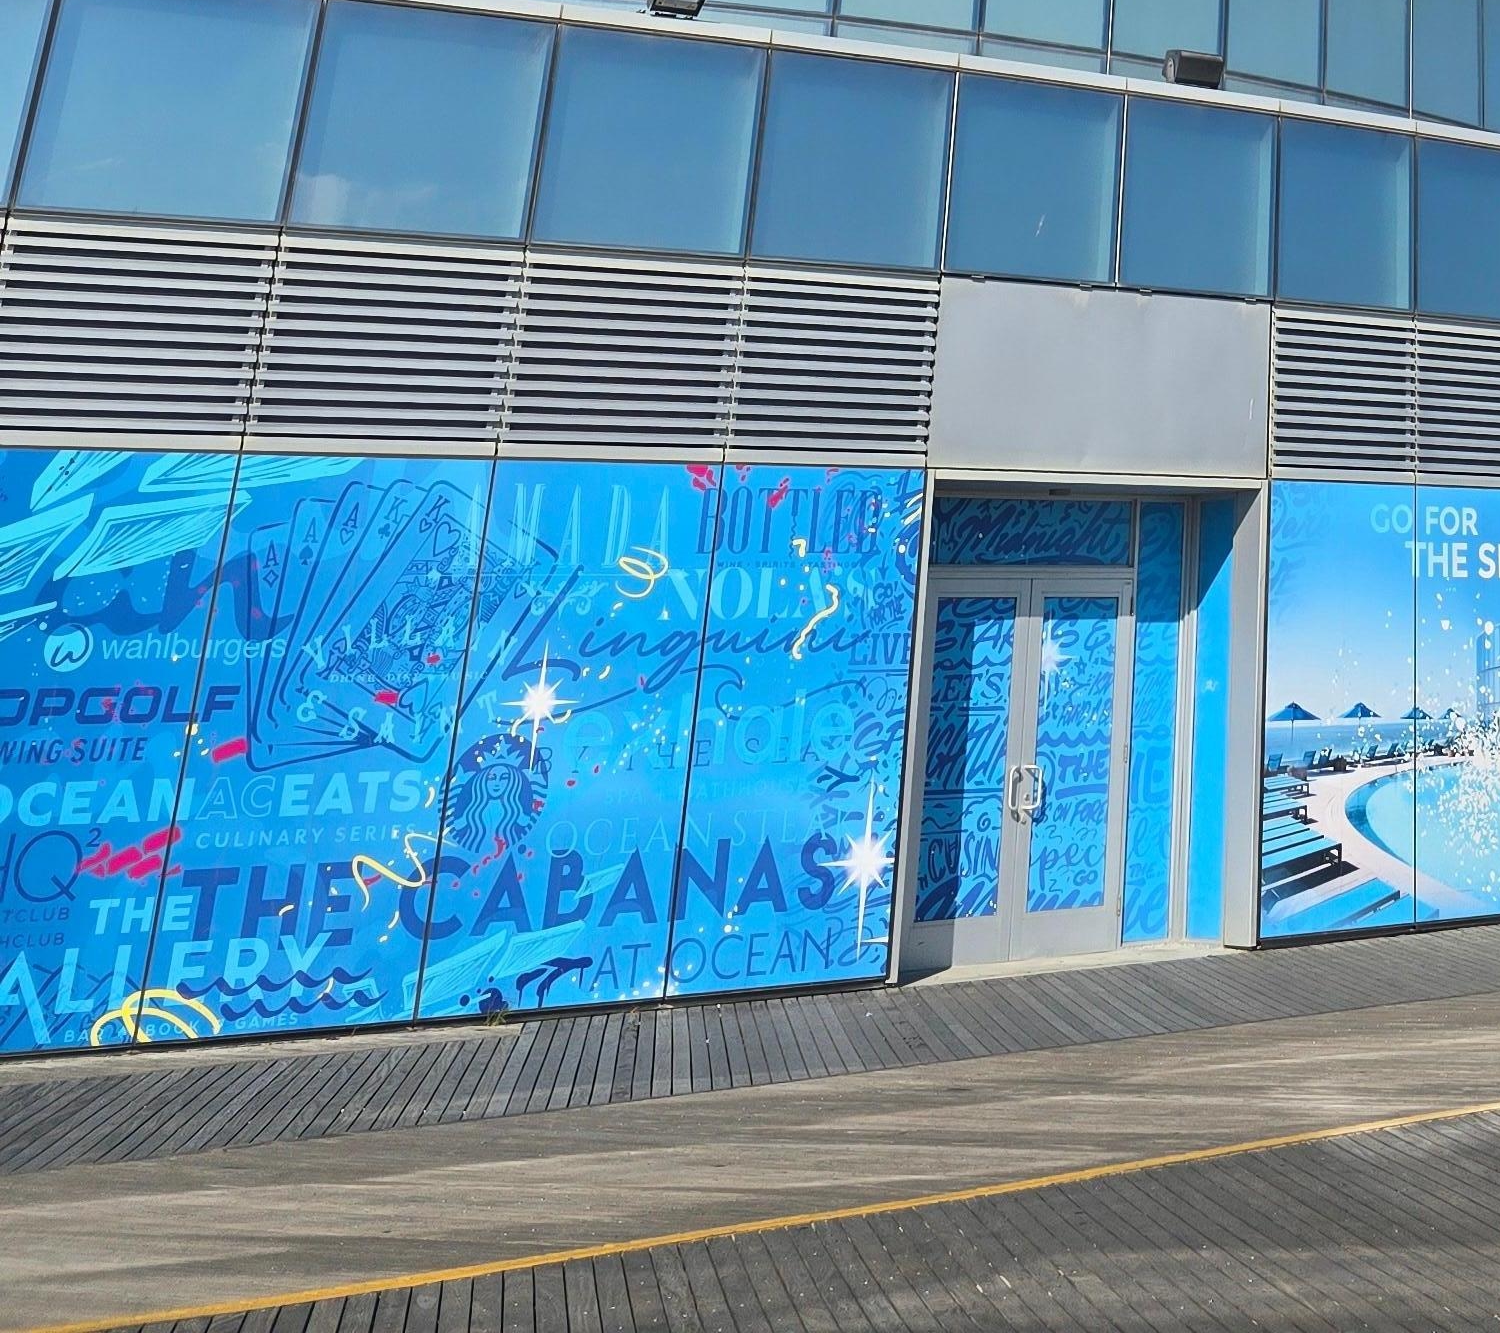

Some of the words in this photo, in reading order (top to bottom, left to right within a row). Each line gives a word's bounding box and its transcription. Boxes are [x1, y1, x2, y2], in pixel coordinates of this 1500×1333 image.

[1370, 503, 1413, 534] GO
[1425, 505, 1479, 536] FOR
[1404, 540, 1468, 578] THE
[102, 632, 287, 664] wahlburgers
[70, 736, 148, 764] SUITE
[195, 827, 325, 850] CULINARY
[335, 822, 417, 844] SERIES
[545, 812, 712, 858] OCEAN
[181, 861, 363, 957] THE
[399, 832, 837, 941] CABANAS
[89, 894, 194, 936] THE
[592, 943, 652, 991] AT
[669, 926, 832, 984] OCEAN
[234, 1013, 299, 1030] GAMES
